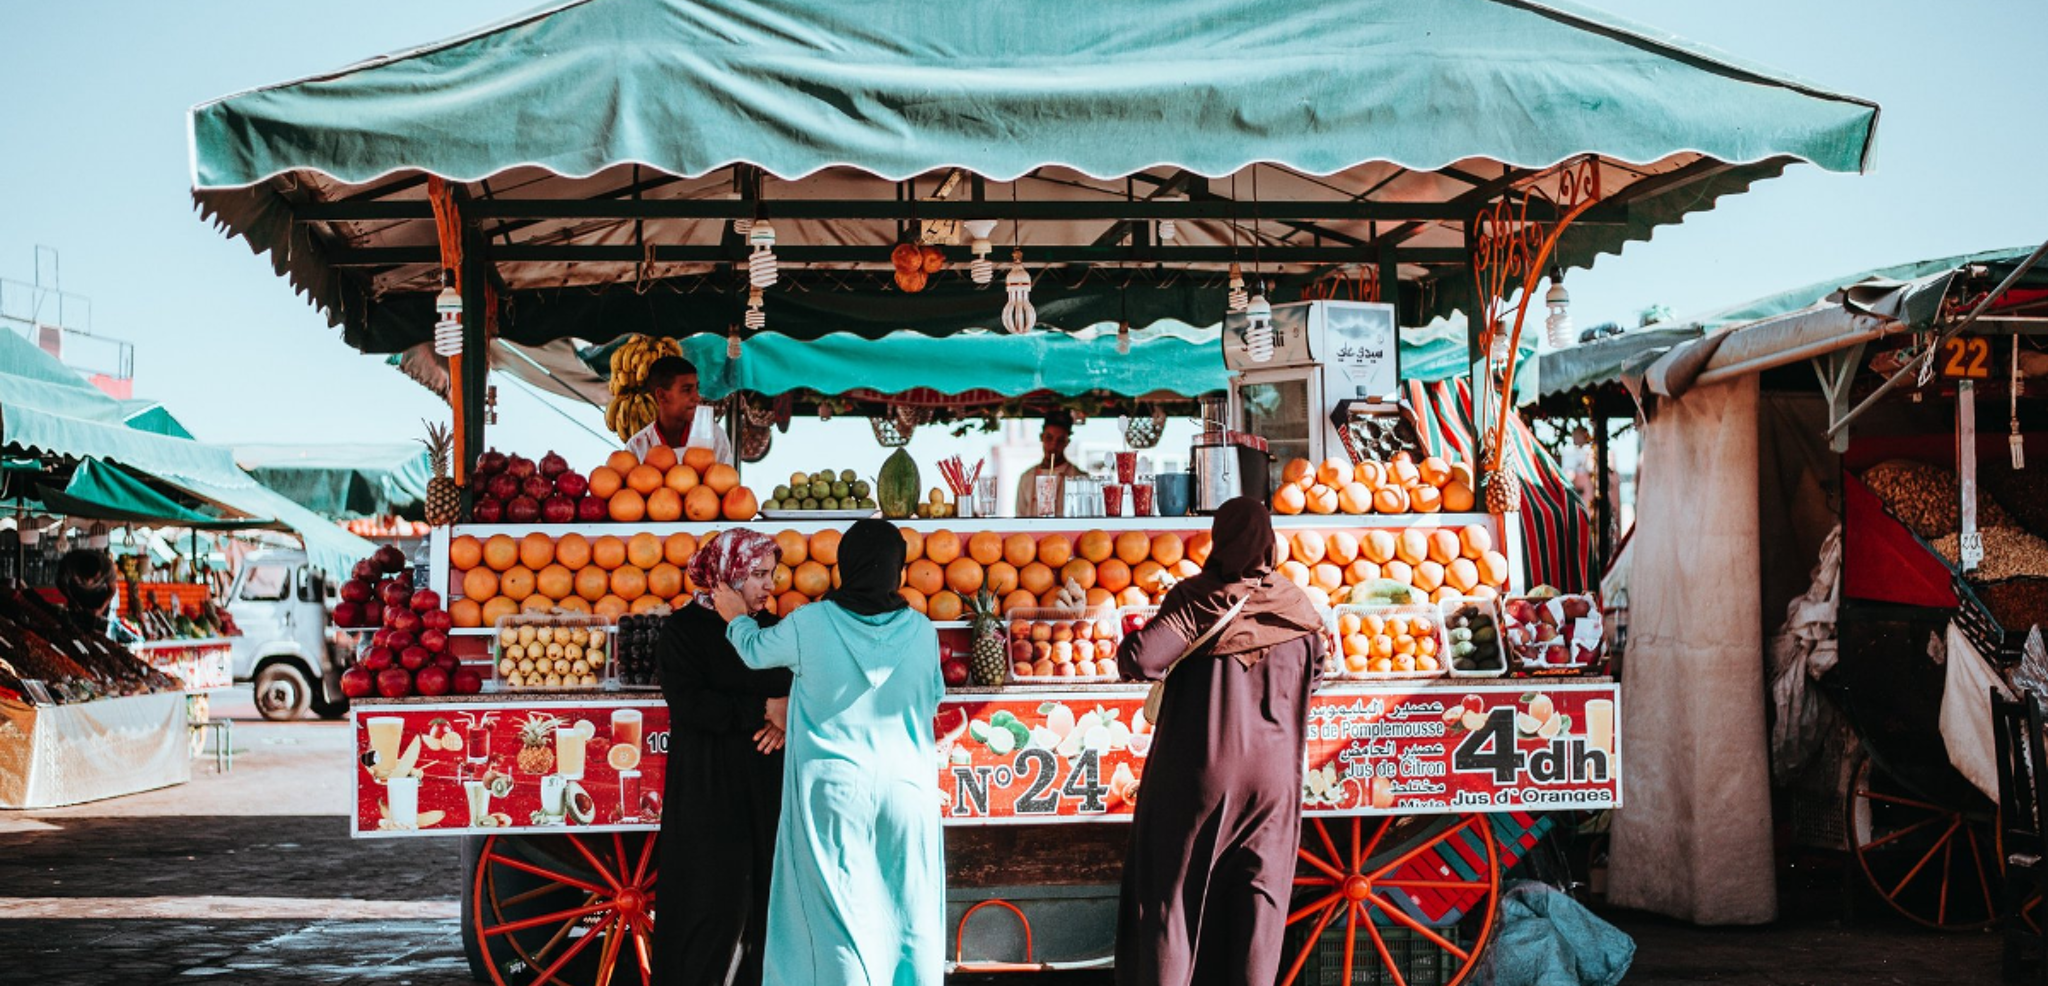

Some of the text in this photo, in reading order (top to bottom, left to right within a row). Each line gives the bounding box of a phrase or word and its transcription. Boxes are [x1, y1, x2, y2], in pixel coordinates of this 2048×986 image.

[1945, 337, 1988, 377] 22
[1321, 722, 1338, 738] de
[1342, 719, 1444, 740] Pomplemousse
[1453, 706, 1608, 784] 4dh
[1347, 760, 1445, 777] Jus de Citron
[1452, 790, 1489, 805] Jus
